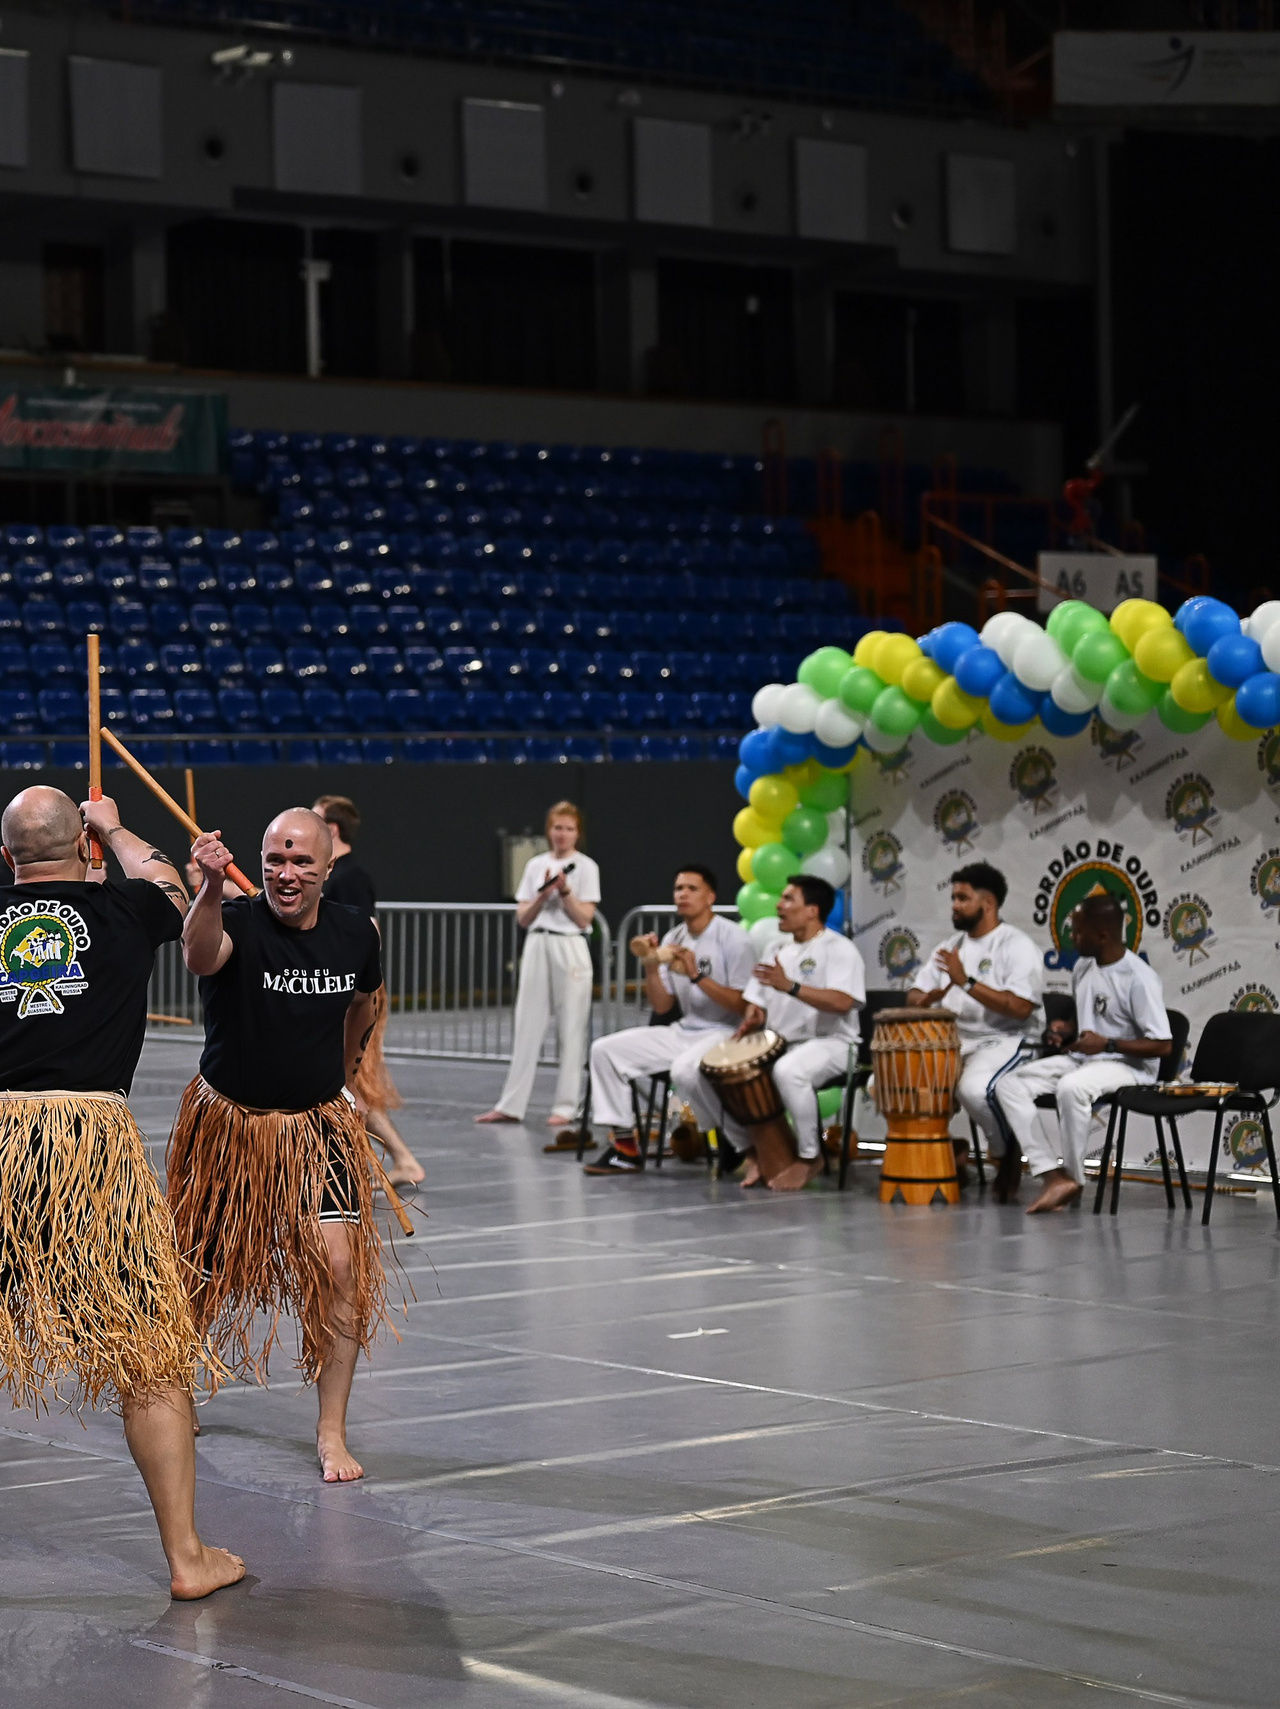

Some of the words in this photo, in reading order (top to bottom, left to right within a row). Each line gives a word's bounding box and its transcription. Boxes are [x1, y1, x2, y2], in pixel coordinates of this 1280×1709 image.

[1033, 844, 1091, 926] CORDÃO
[1096, 839, 1124, 863] DE
[1126, 855, 1161, 928] OURO
[36, 902, 58, 913] DE
[60, 907, 89, 950] OURO
[263, 971, 356, 995] MACULELE
[283, 968, 307, 977] SOU
[314, 968, 330, 977] EU
[55, 982, 88, 990] KALININGRAD
